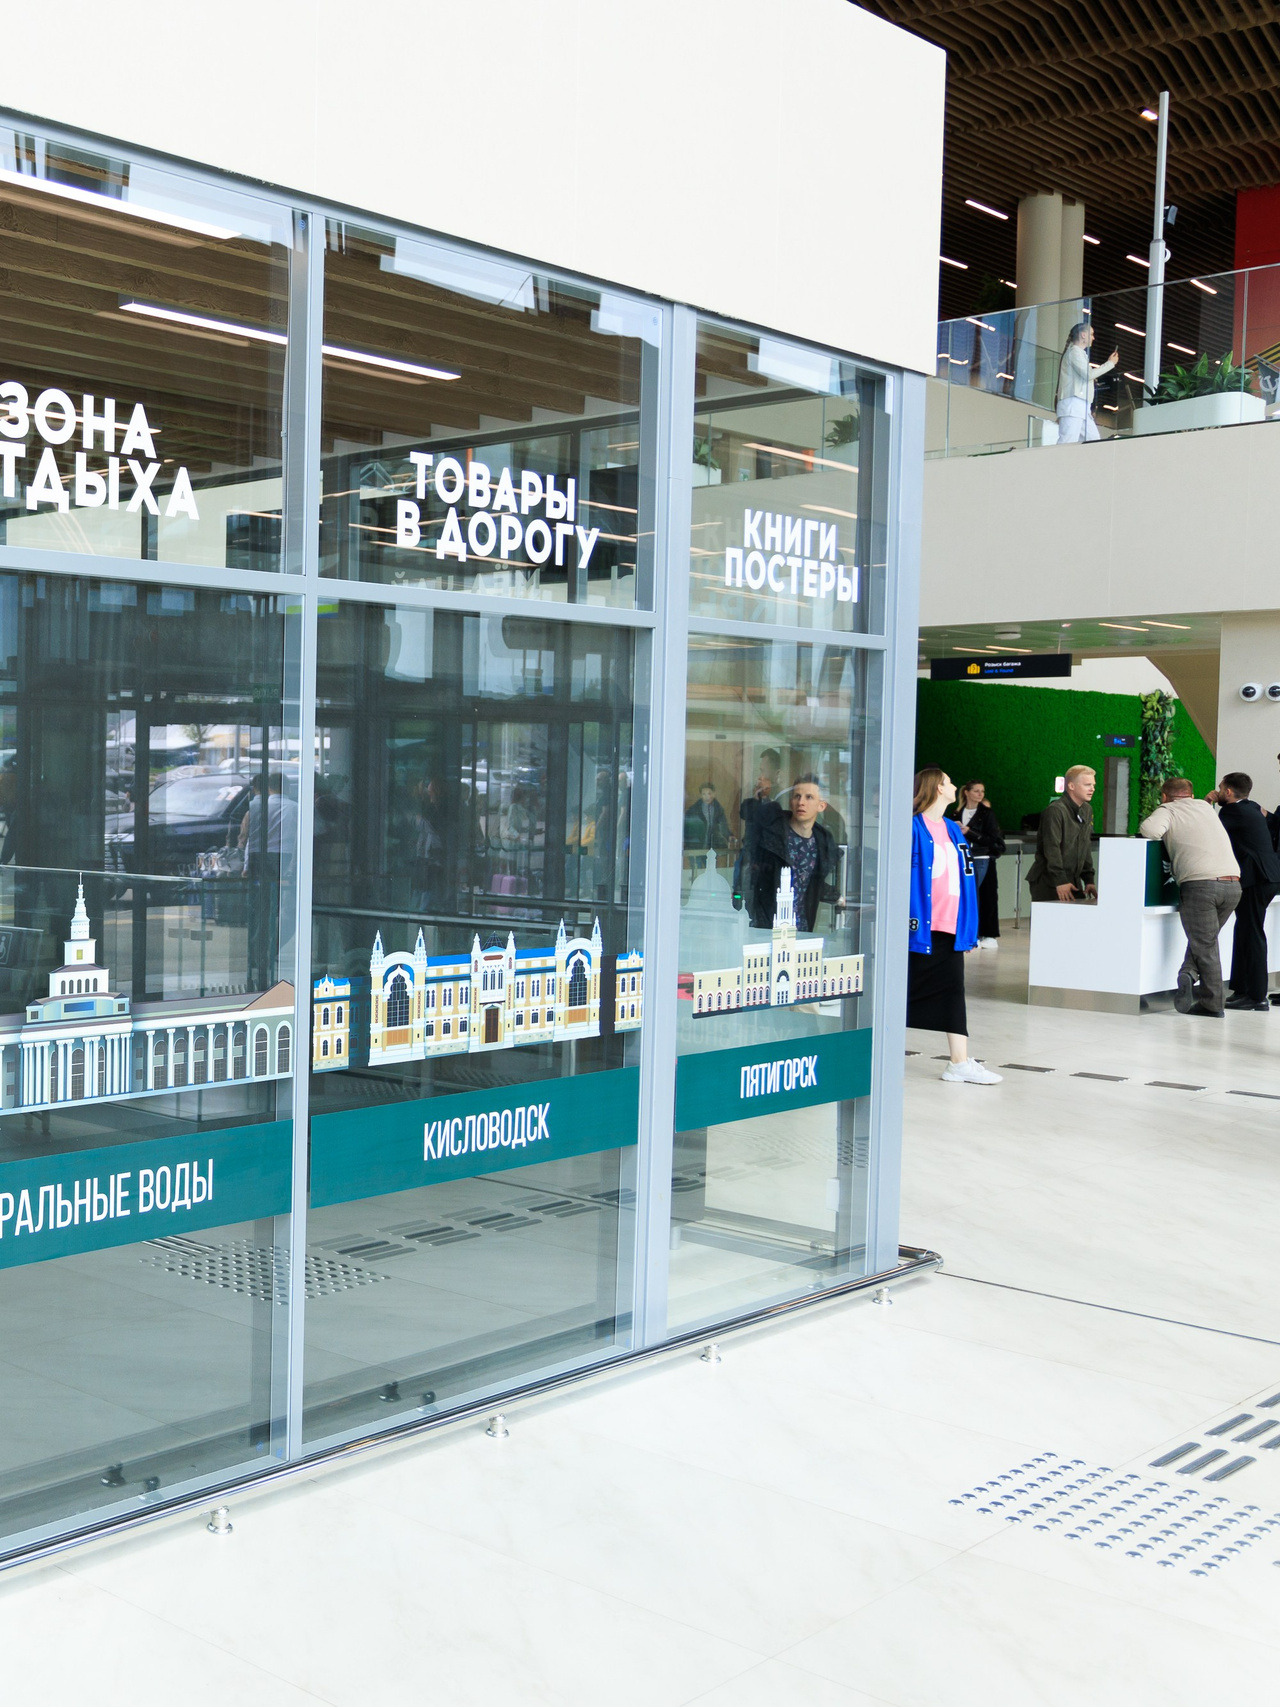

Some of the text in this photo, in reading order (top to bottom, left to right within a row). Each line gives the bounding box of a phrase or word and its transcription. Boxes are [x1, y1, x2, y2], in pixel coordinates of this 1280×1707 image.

[409, 451, 576, 521] ТОВАРЫ
[396, 499, 600, 569] В ДОРОГУ
[743, 508, 837, 561] КНИГИ
[725, 547, 859, 603] ПОСТЕРЫ
[739, 1054, 818, 1099] ПЯТИГОРСК
[423, 1102, 550, 1161] КИСЛОВОДСК
[138, 1158, 214, 1213] ВОДЫ
